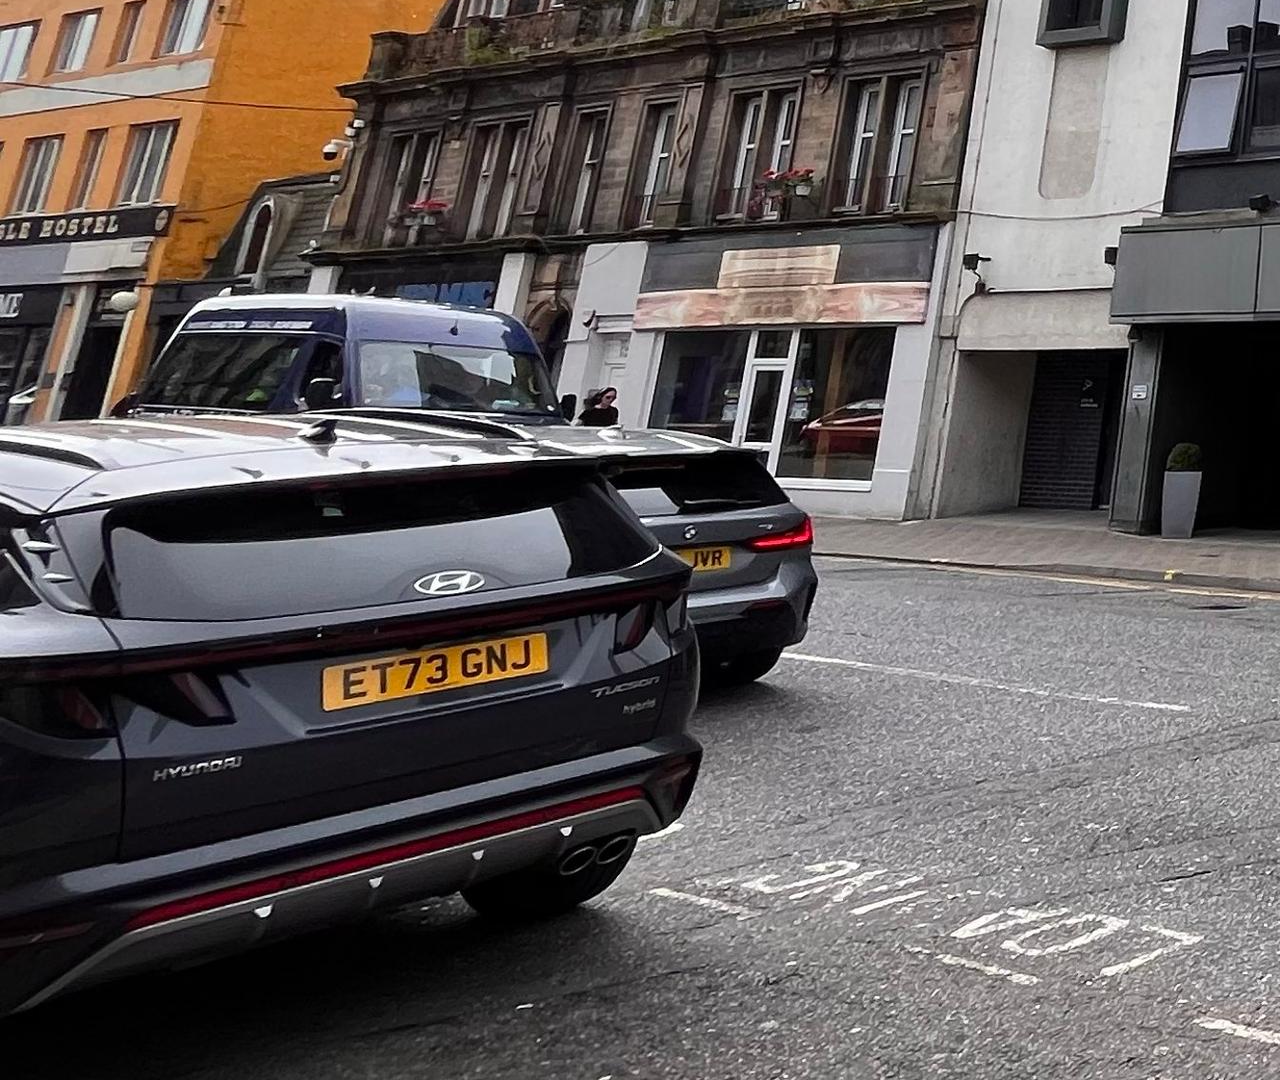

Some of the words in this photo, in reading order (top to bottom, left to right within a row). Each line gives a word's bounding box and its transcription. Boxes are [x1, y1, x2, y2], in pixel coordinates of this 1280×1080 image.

[39, 215, 119, 238] HOSTEL
[693, 549, 723, 568] JVR
[342, 653, 449, 700] ET73
[460, 639, 531, 678] GNJ
[152, 756, 243, 782] HYUNDAI
